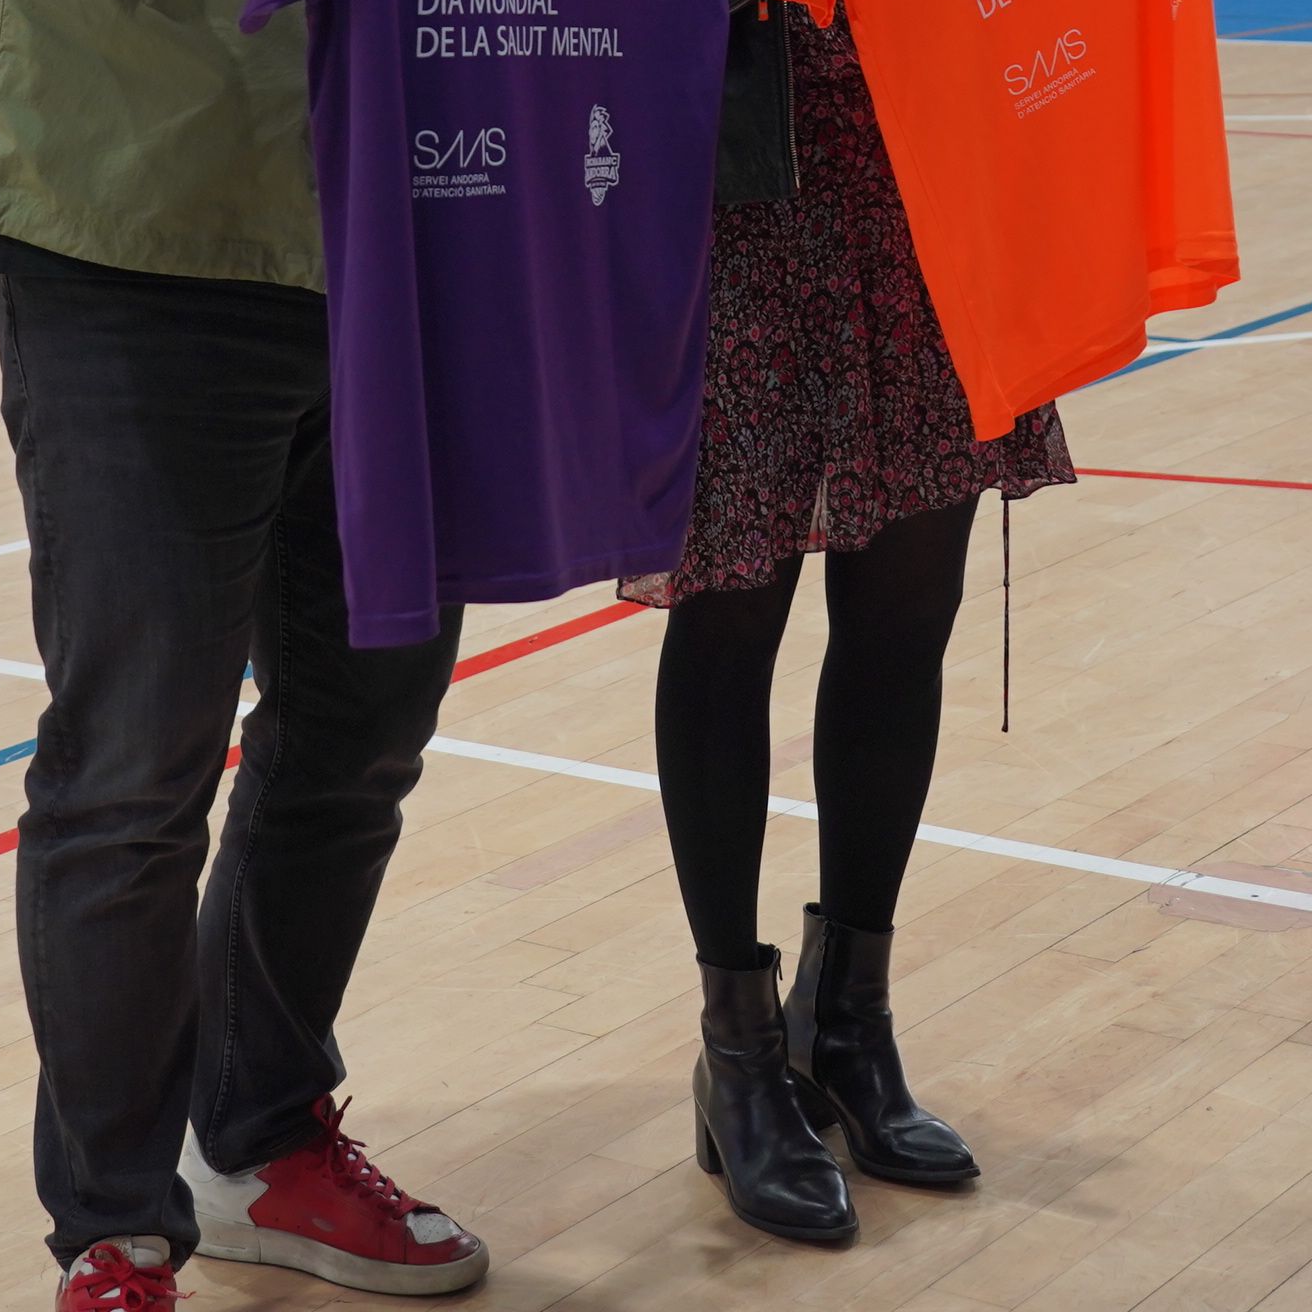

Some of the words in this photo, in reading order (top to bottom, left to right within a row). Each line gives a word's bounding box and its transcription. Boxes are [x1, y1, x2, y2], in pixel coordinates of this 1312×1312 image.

[416, 26, 456, 58] DE
[461, 25, 491, 57] LA
[496, 25, 547, 57] SALUT
[551, 26, 624, 57] MENTAL
[412, 175, 449, 186] SERVEI
[412, 186, 464, 199] D'ATENCIÓ
